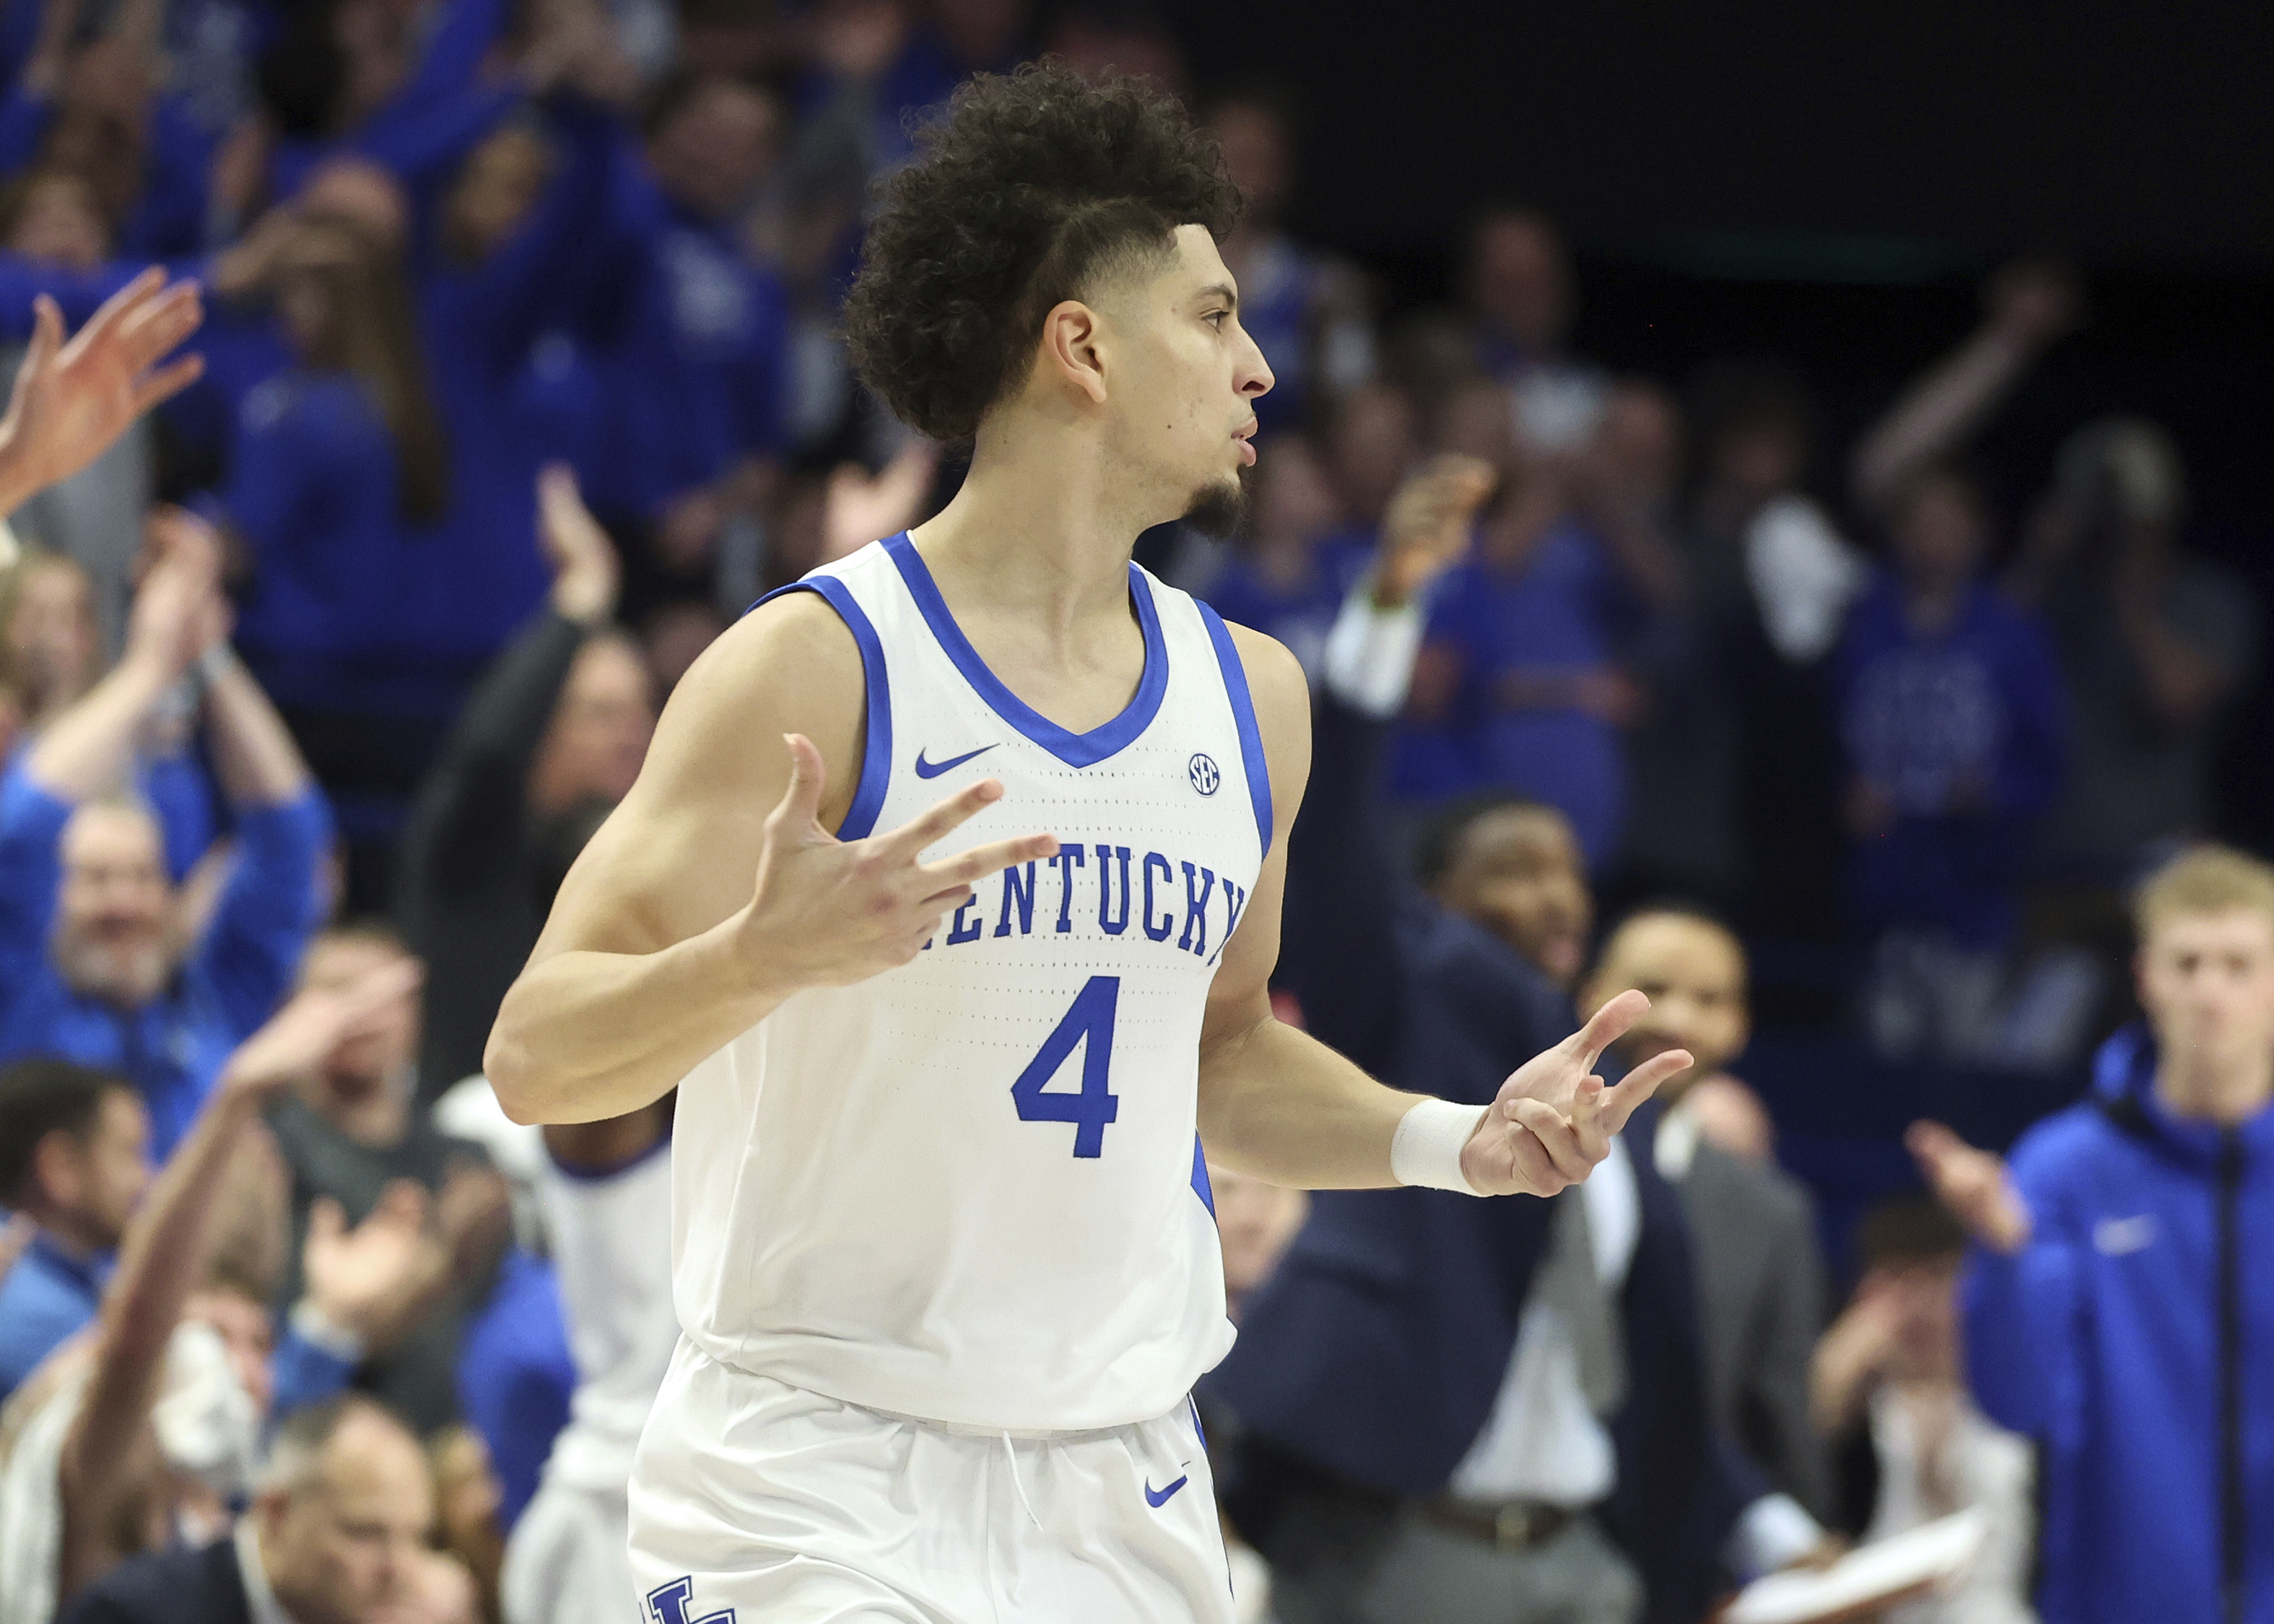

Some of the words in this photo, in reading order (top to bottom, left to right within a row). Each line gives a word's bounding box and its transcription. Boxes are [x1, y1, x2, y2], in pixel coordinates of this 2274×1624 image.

[1189, 754, 1219, 795] SEC
[920, 843, 1245, 967] ENTUCKY
[1011, 975, 1120, 1158] 4
